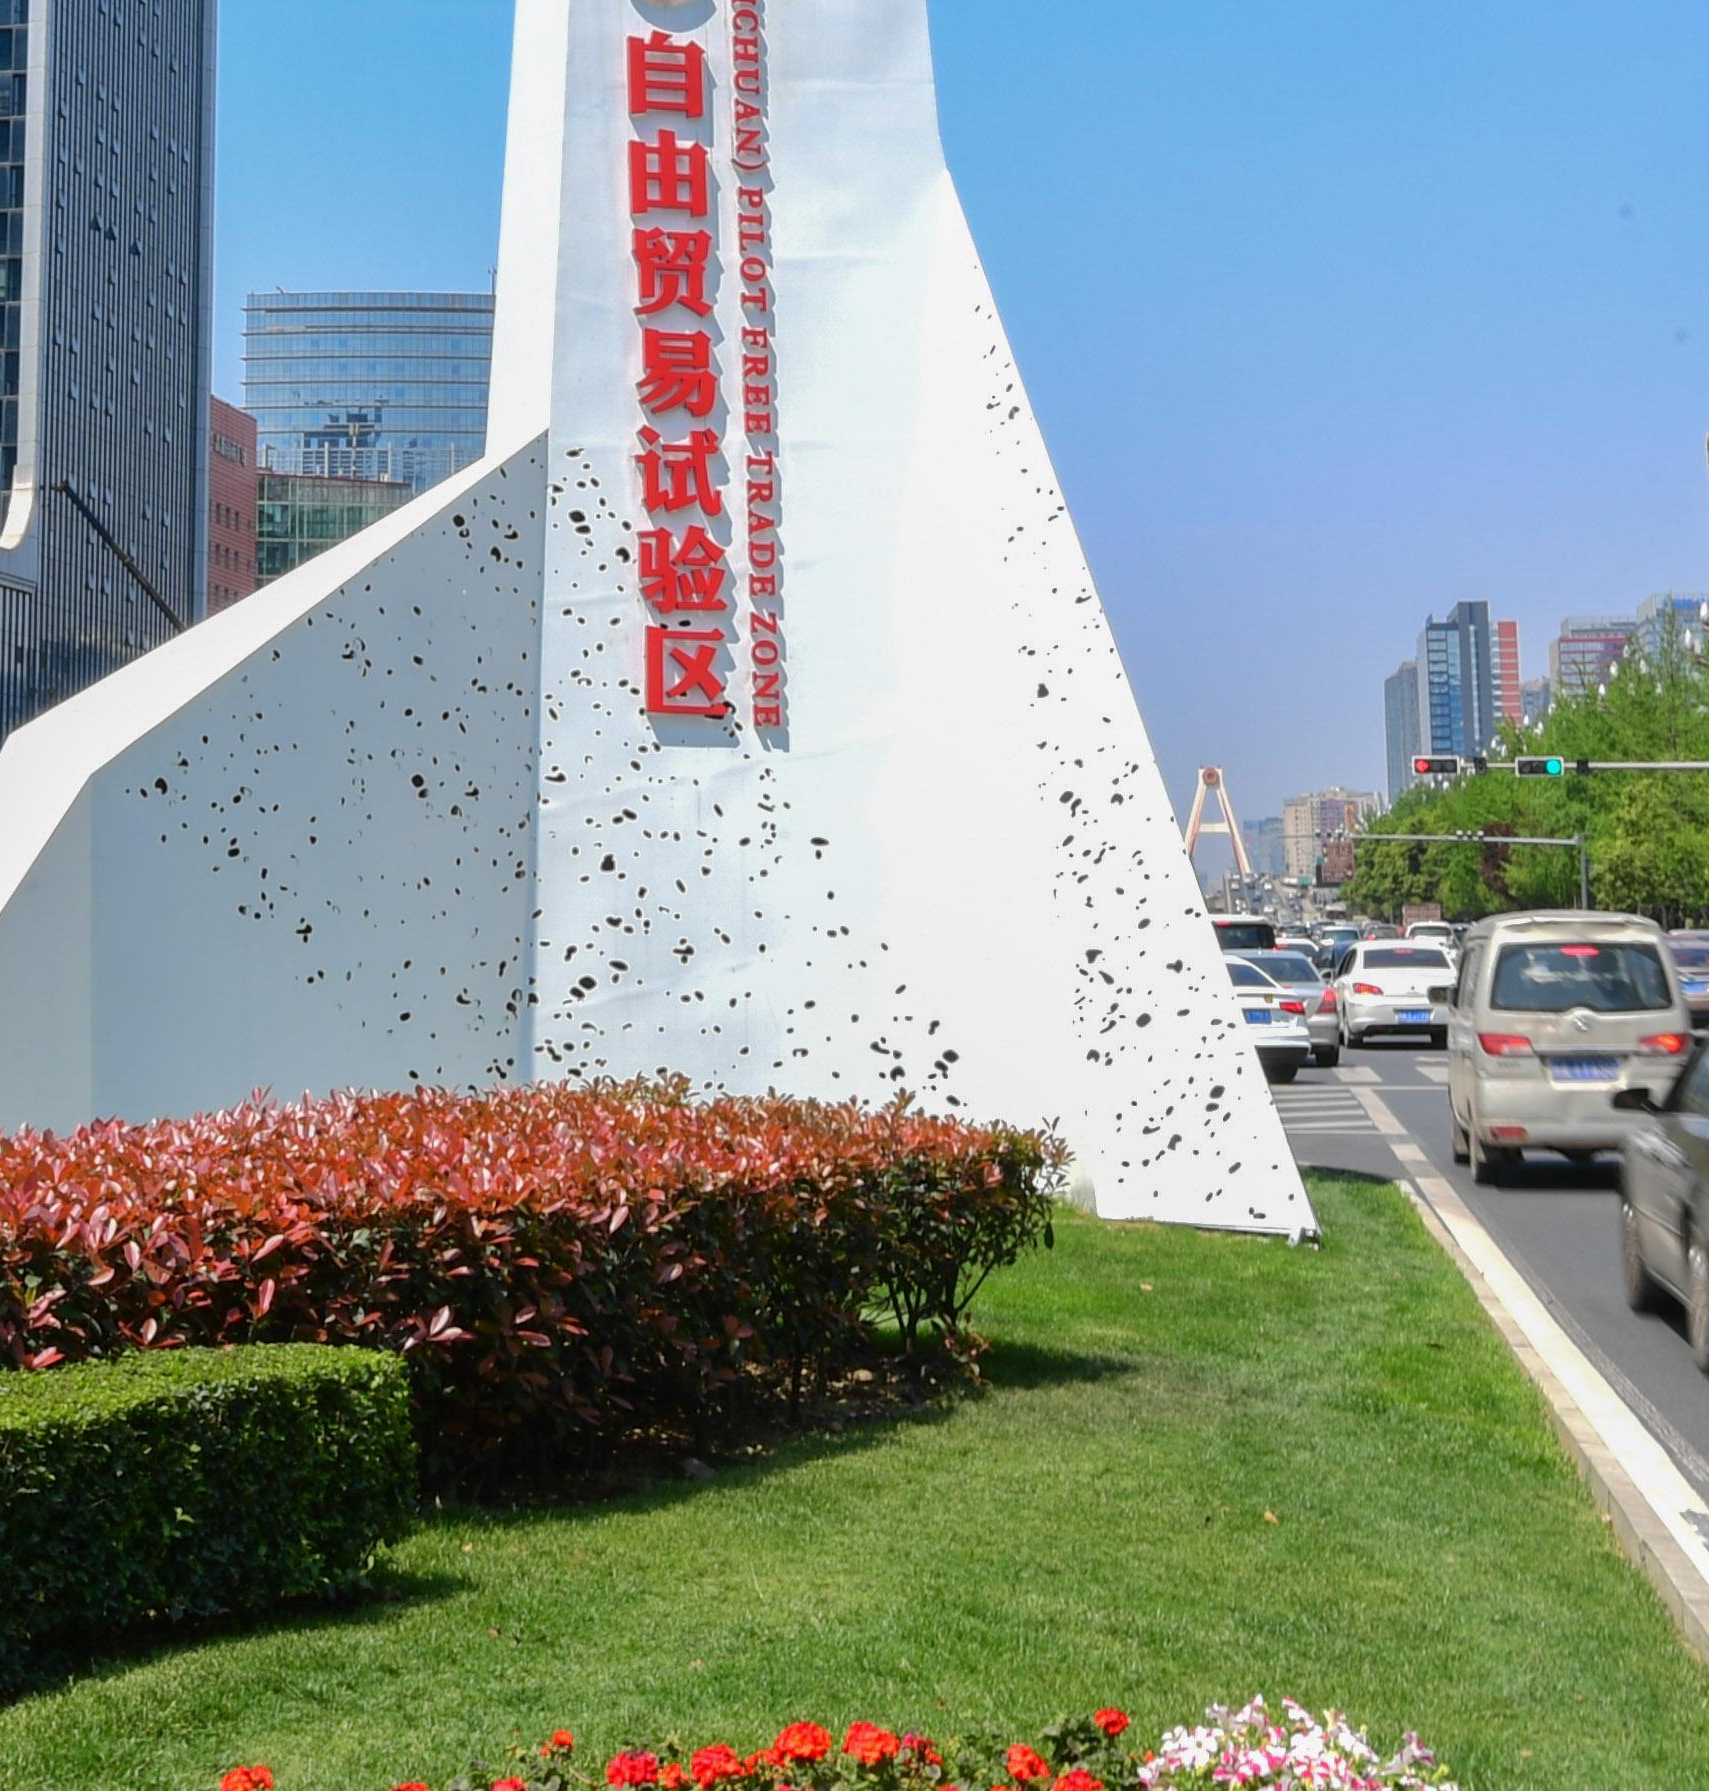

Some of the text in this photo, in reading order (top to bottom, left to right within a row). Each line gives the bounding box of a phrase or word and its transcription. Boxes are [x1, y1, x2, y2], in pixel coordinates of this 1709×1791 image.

[737, 186, 768, 312] PILOT
[741, 327, 772, 434] FREE
[745, 453, 777, 597] TRADE
[749, 612, 781, 727] ZONE
